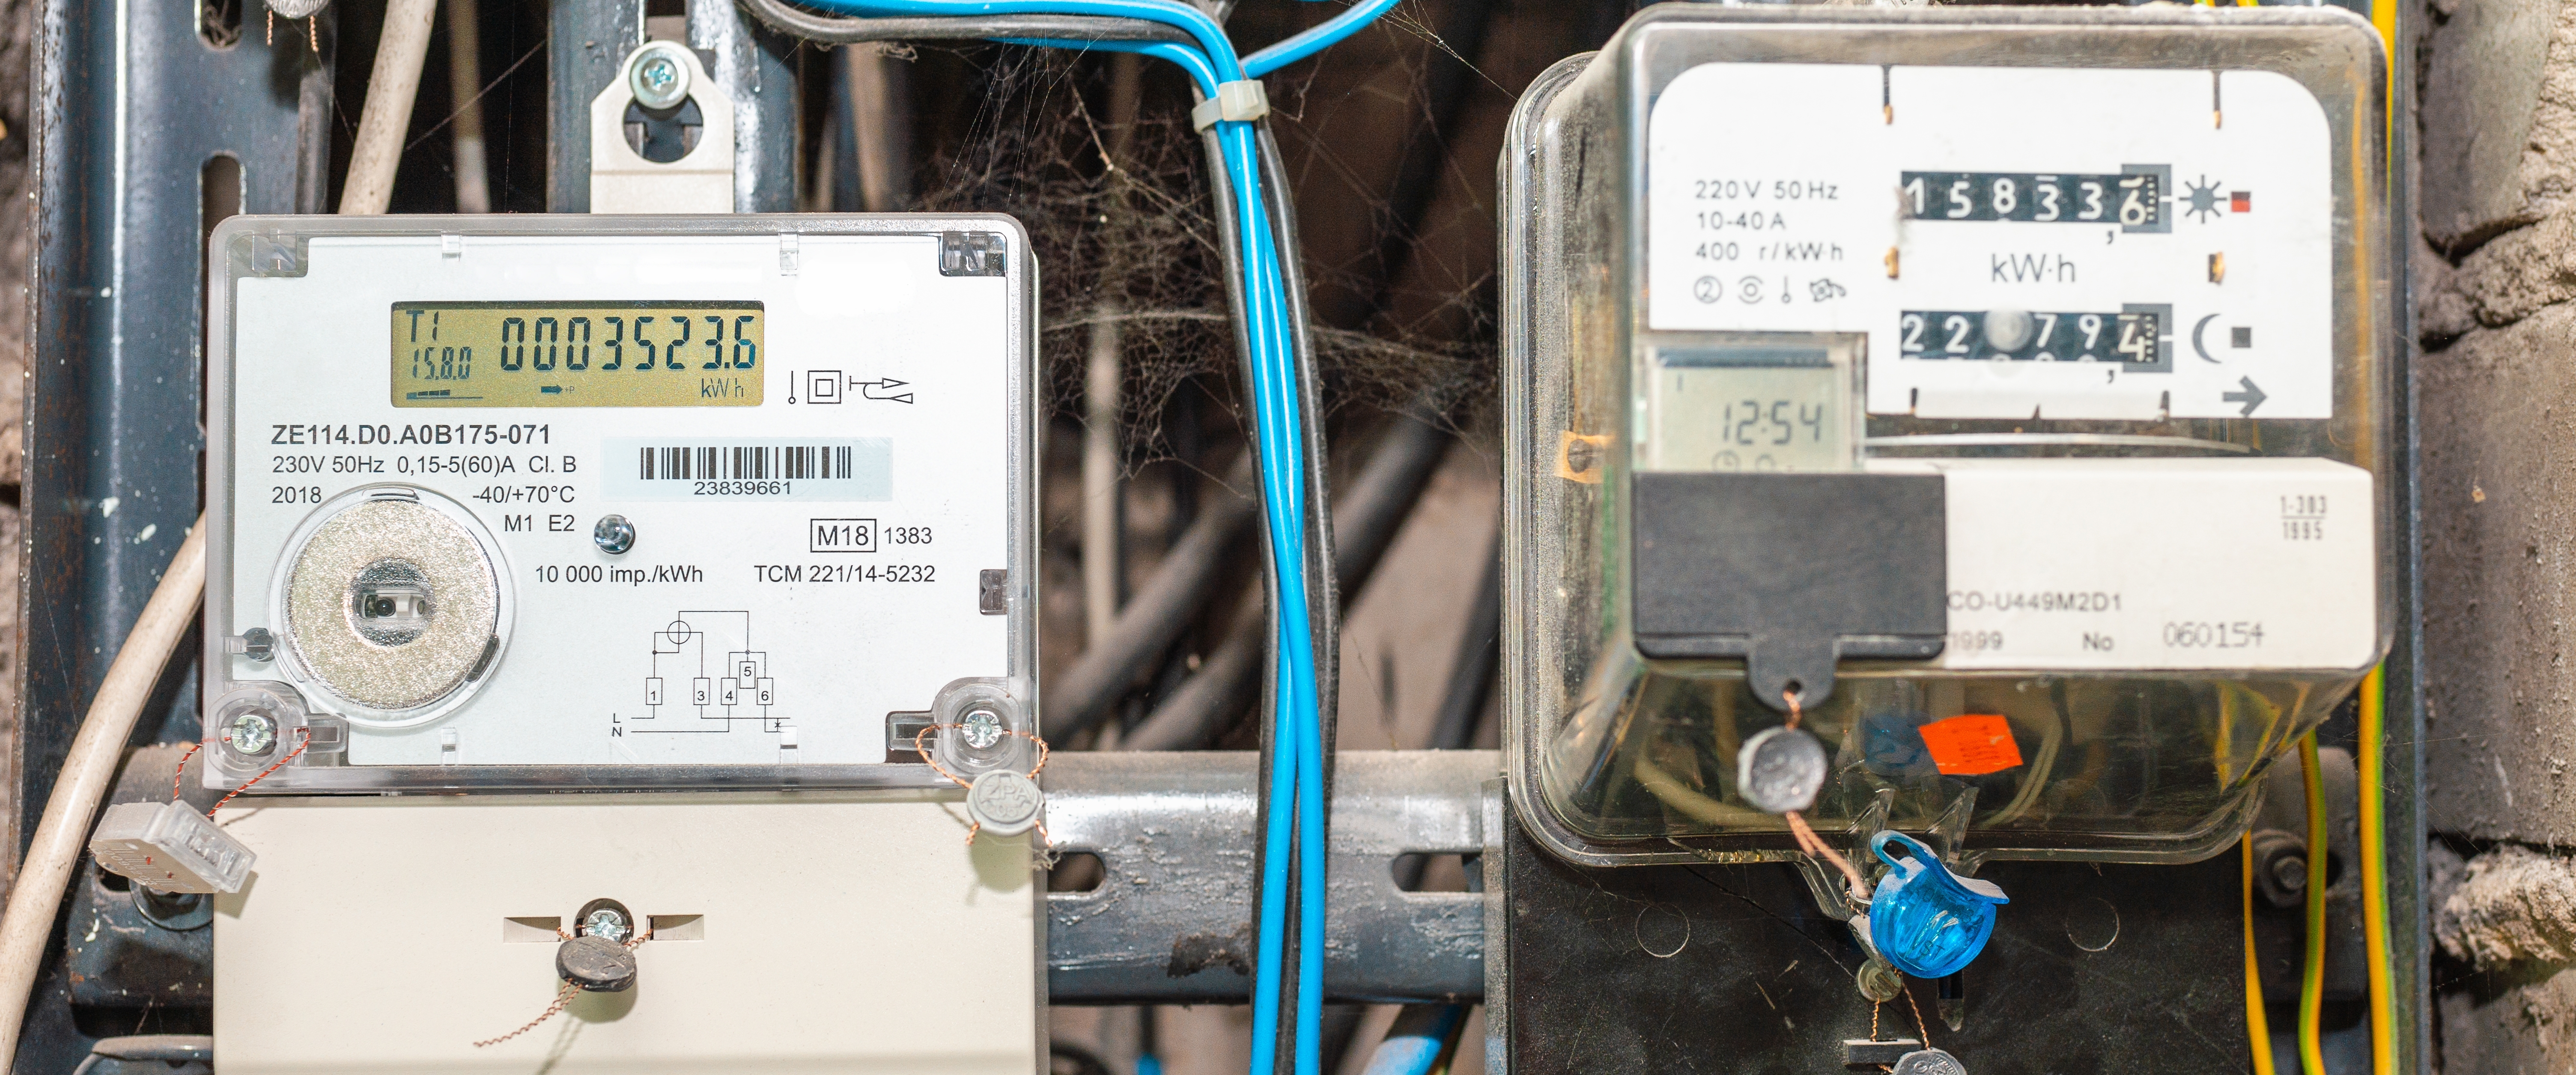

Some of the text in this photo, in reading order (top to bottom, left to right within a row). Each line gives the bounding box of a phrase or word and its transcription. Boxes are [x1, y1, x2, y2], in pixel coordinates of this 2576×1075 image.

[1696, 242, 1739, 261] 400
[501, 316, 756, 370] 0003523.6
[1723, 401, 1823, 445] 12:54
[271, 424, 549, 444] ZE114.D0.A0B175-071
[272, 456, 325, 473] 230V
[332, 456, 385, 473] 50Hz
[397, 456, 516, 478] 0,15-5(60)A
[563, 456, 576, 473] B
[272, 485, 575, 503] 2018 -40/+70°C
[694, 481, 790, 495] 23839661
[505, 515, 575, 532] M1 E2
[818, 525, 932, 546] M18 1383
[536, 565, 703, 587] 10 000 imp./kWh
[754, 565, 935, 582] TCM 221/14-5232
[2083, 632, 2114, 651] No
[2163, 622, 2264, 648] 060154
[744, 666, 752, 677] 5
[650, 691, 769, 701] 1 3 4 6
[613, 713, 621, 724] L
[611, 727, 622, 737] N
